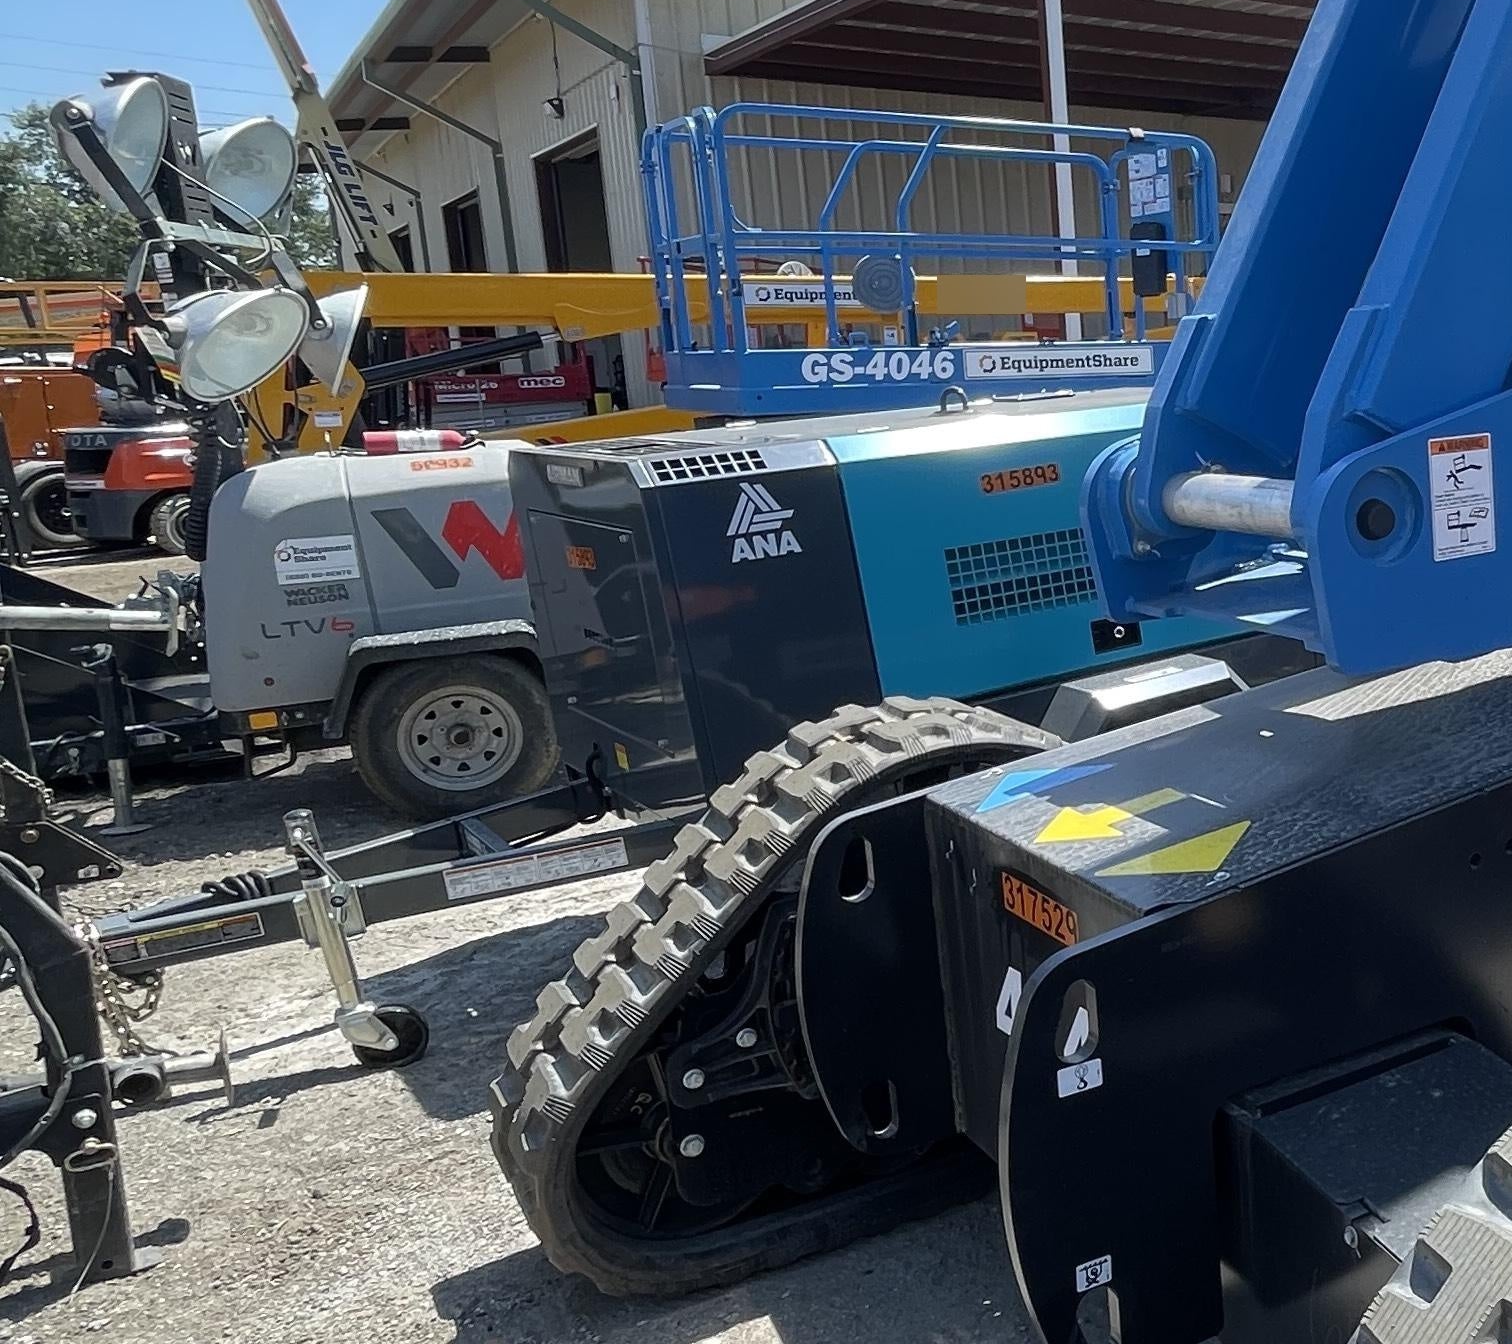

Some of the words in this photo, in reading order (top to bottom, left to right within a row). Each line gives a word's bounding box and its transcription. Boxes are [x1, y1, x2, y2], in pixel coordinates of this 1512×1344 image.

[323, 140, 355, 177] JLG
[344, 183, 378, 226] LIFT
[774, 288, 858, 303] Equipent
[802, 351, 955, 383] GS-4046
[1000, 354, 1139, 373] EquipmentShare
[981, 464, 1058, 494] 315893
[732, 530, 802, 564] ANA
[284, 583, 347, 597] WACKER
[286, 593, 350, 607] NEUSON
[260, 616, 355, 639] LTV6
[1004, 875, 1078, 946] 317529
